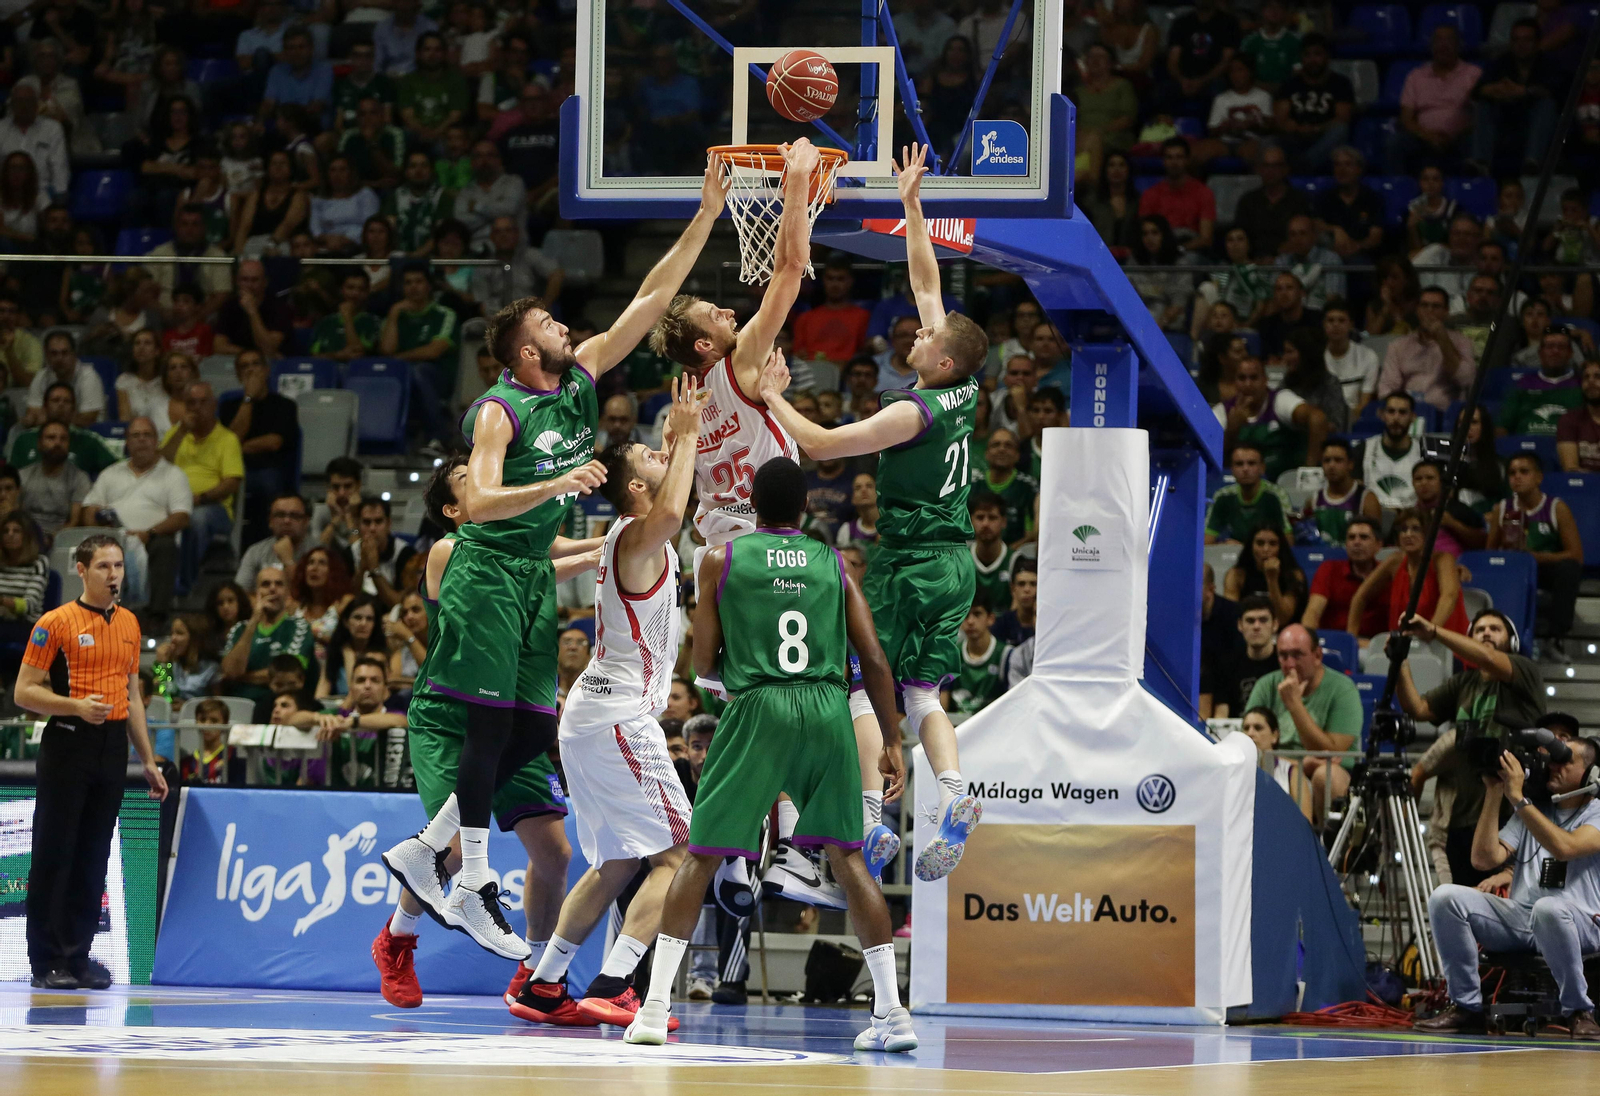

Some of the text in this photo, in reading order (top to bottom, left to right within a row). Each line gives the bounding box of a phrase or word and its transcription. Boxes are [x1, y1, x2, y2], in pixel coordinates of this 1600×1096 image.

[989, 141, 1007, 158] liga
[989, 155, 1024, 164] endesa
[924, 218, 974, 246] RTIUM.es
[1093, 363, 1108, 428] MONDO
[710, 446, 756, 503] 25
[939, 432, 970, 499] 21
[766, 549, 807, 568] FOGG
[1071, 546, 1101, 556] Unicaja
[777, 610, 809, 673] 8
[967, 782, 1119, 804] Málaga Wagen
[216, 822, 316, 922] liga
[964, 893, 1019, 921] Das
